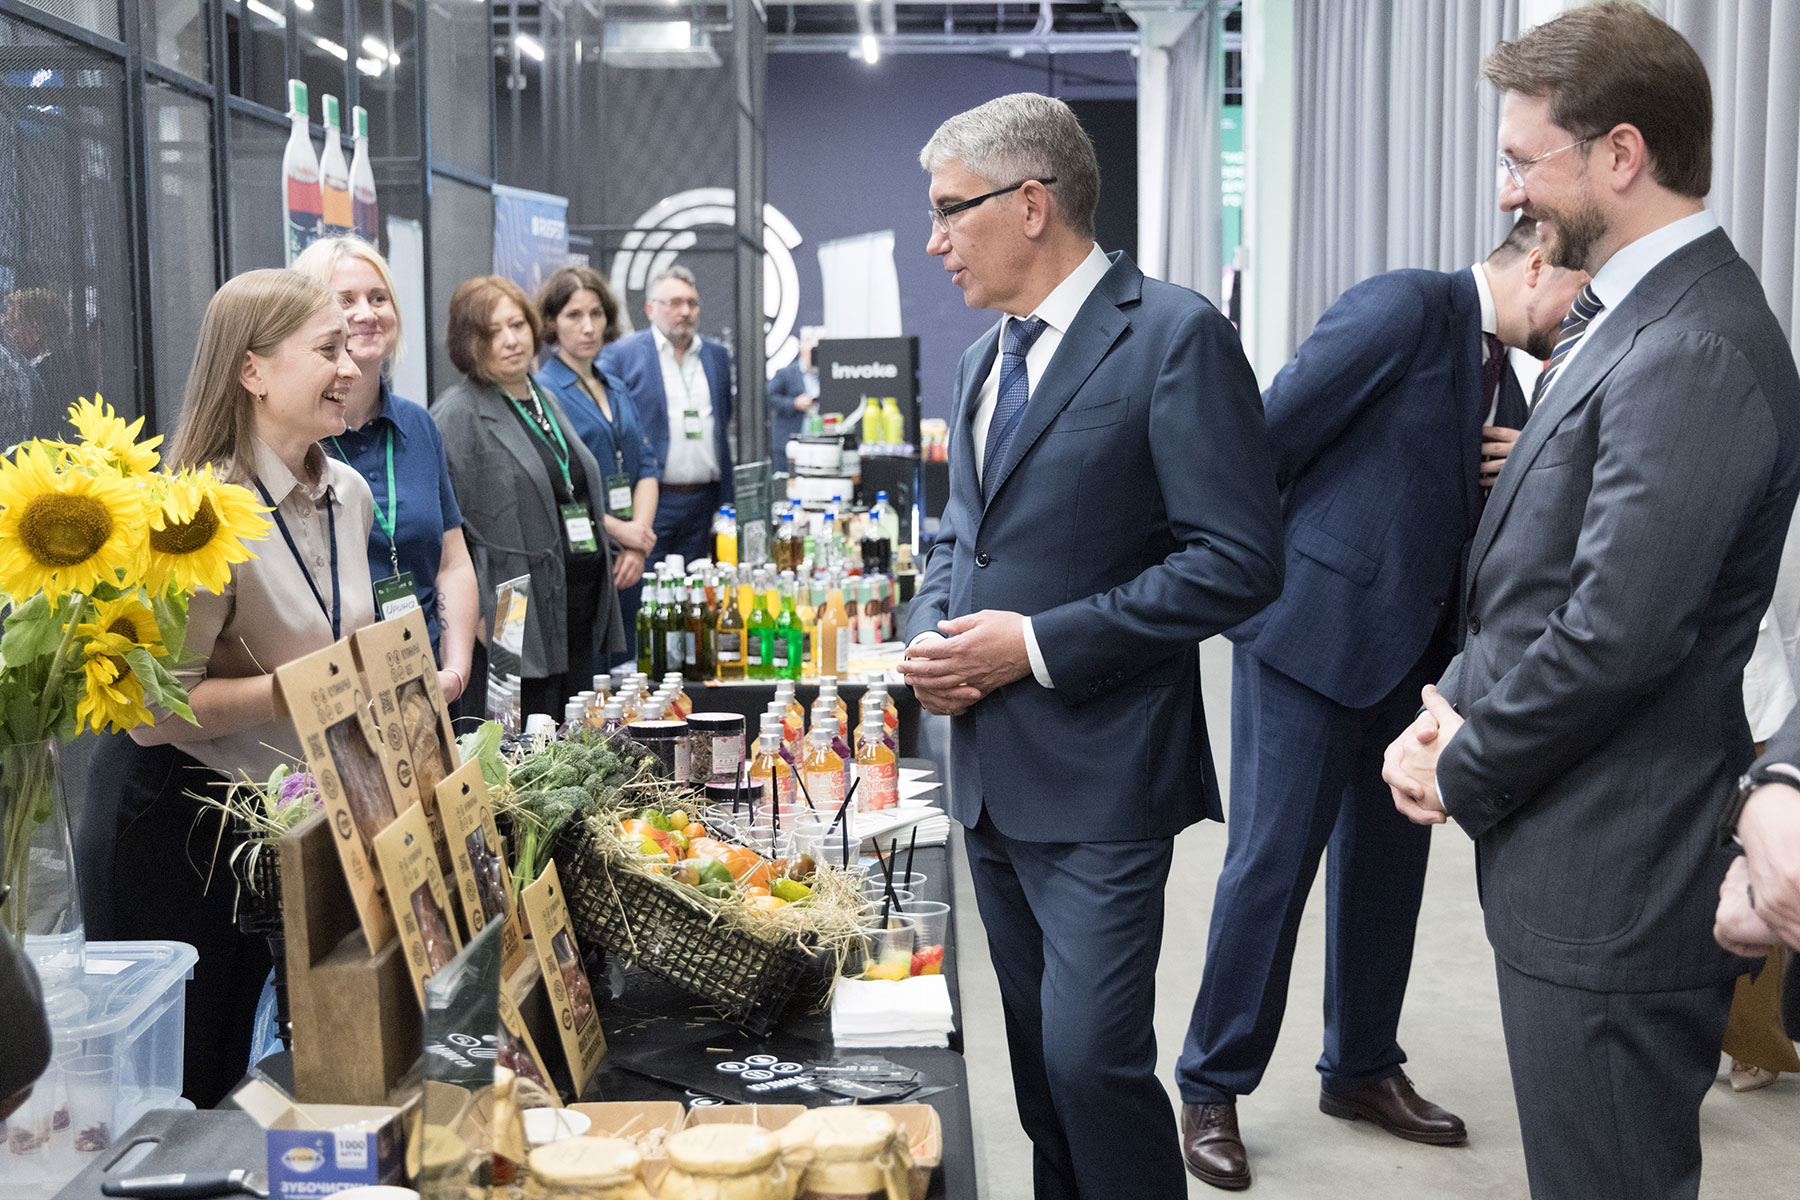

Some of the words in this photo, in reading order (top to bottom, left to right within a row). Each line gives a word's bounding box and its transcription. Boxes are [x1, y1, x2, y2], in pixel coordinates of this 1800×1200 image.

[831, 361, 898, 379] invoke
[339, 1140, 365, 1149] 1000
[280, 1180, 369, 1193] ЗУБОЧИС
